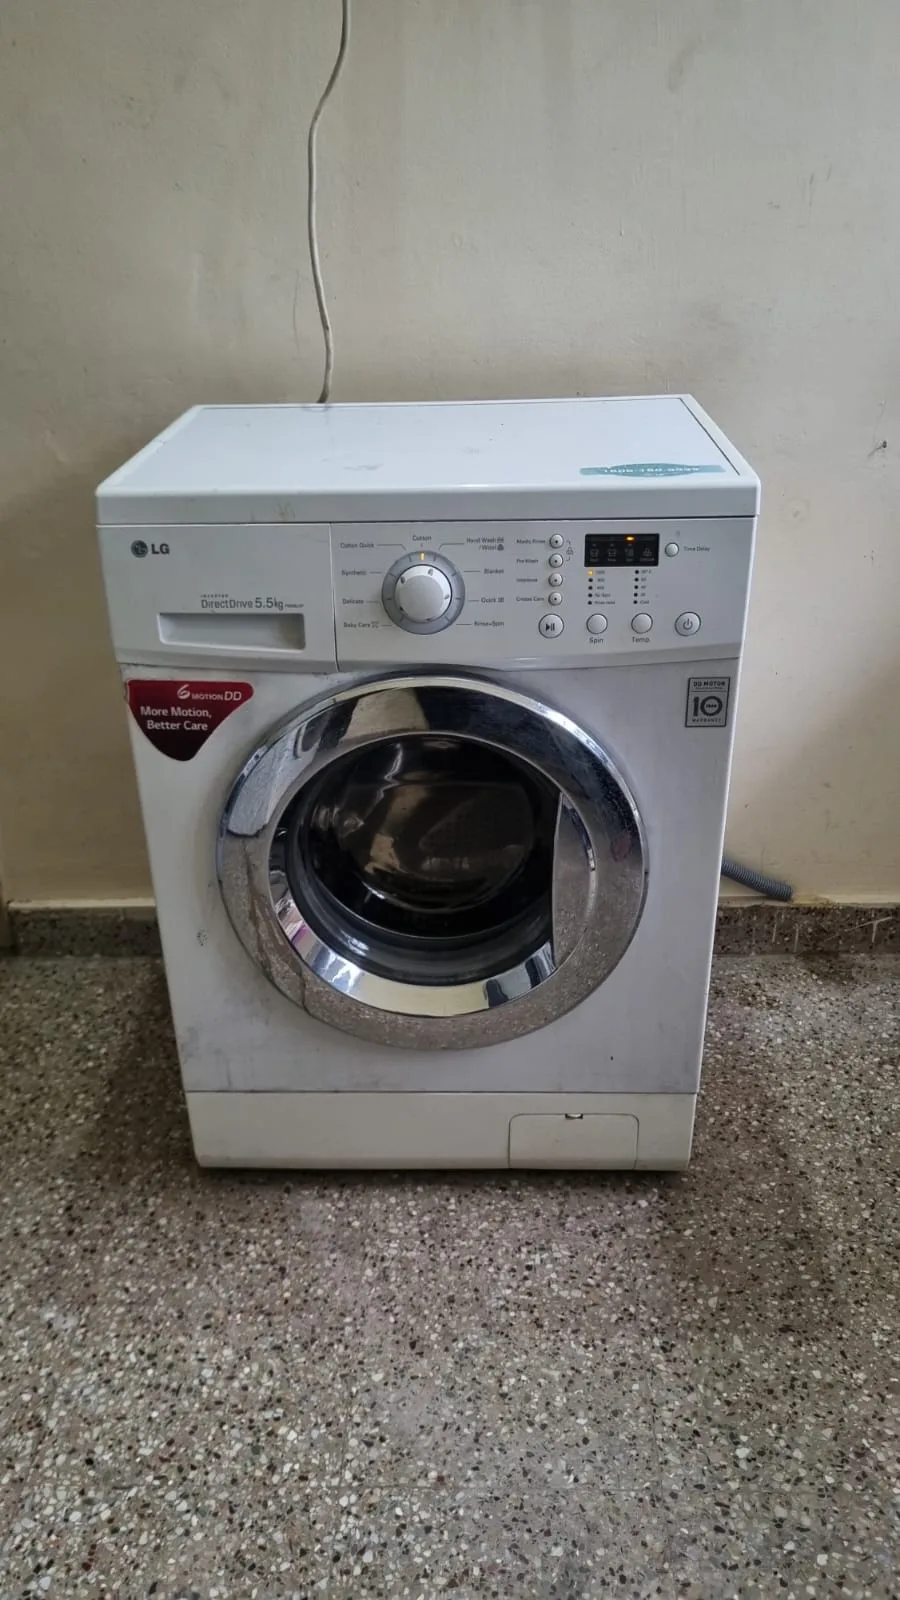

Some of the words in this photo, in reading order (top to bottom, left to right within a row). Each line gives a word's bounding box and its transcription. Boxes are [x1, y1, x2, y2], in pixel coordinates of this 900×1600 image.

[151, 543, 170, 555] LG
[140, 706, 168, 716] More
[170, 707, 212, 718] Motion,
[146, 720, 180, 730] Better
[184, 720, 208, 731] Care
